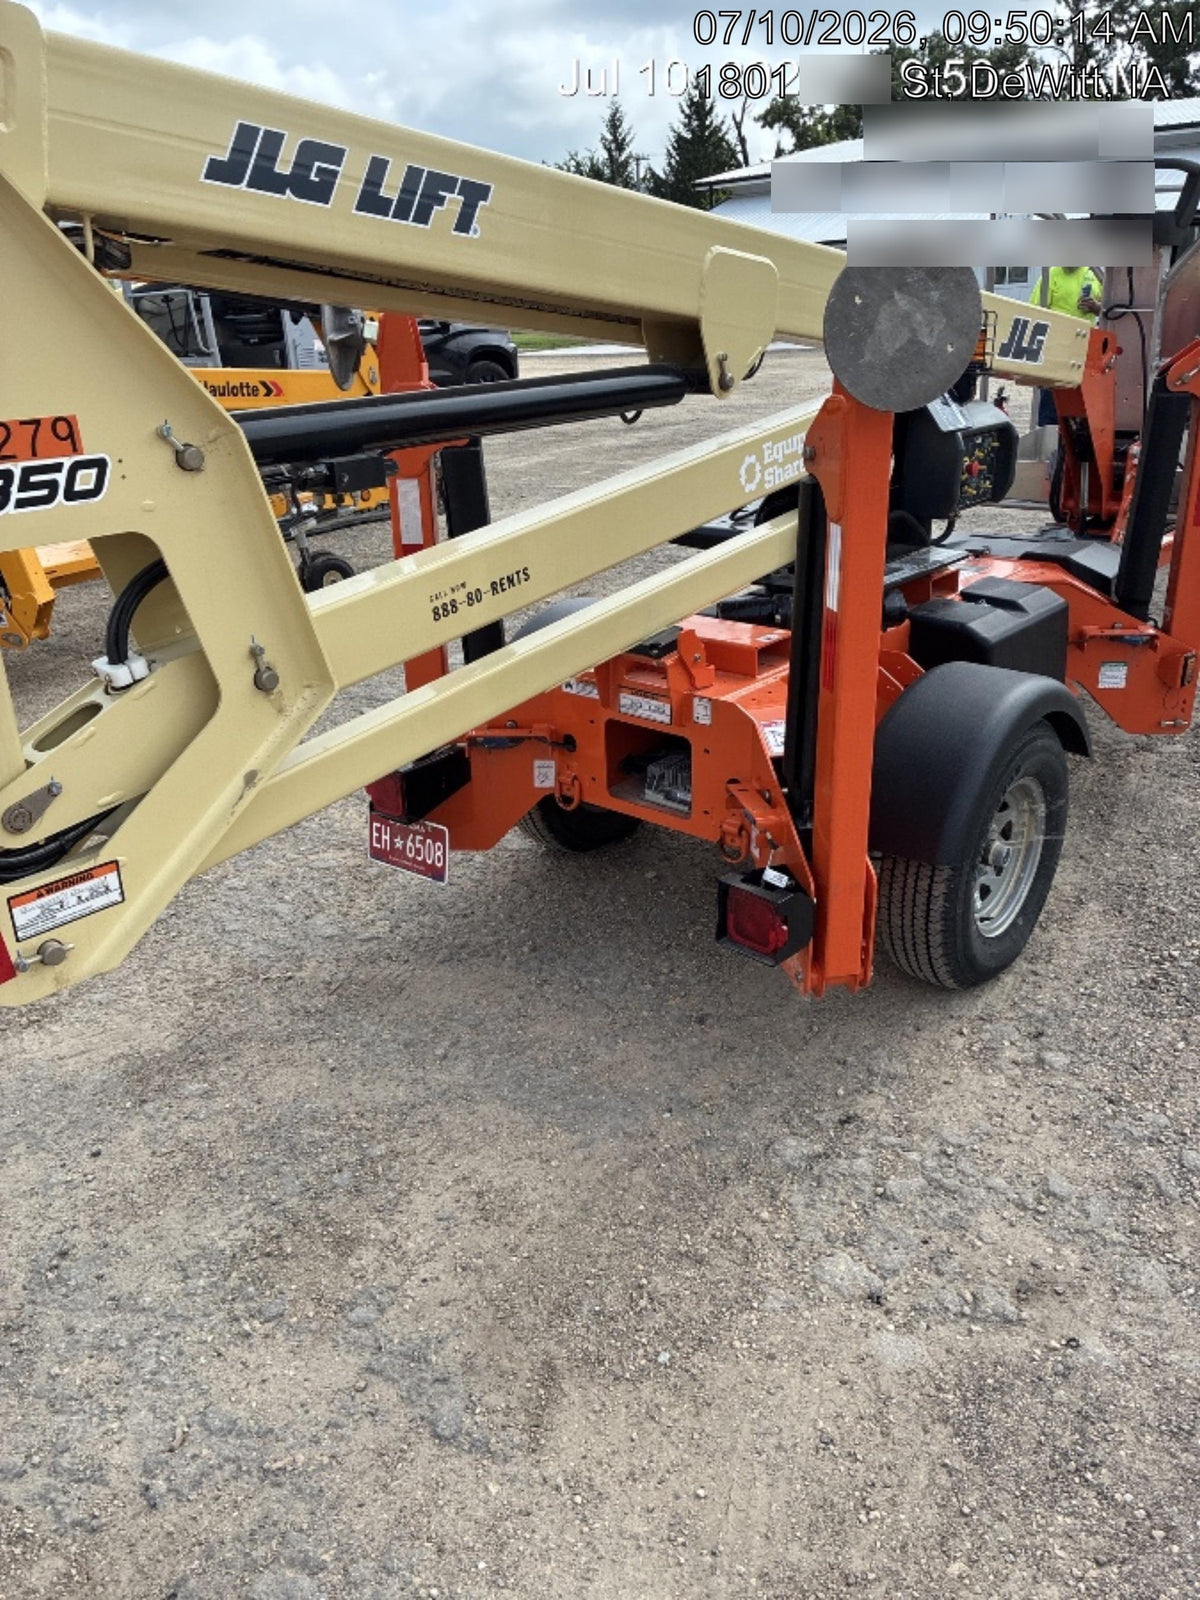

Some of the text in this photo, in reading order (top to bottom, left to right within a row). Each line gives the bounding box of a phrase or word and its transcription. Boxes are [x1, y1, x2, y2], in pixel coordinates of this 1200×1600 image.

[199, 120, 494, 237] JLG LIFT
[995, 315, 1050, 365] JLG
[432, 567, 531, 621] 888-80-RENTS
[372, 822, 391, 852] EH
[406, 833, 444, 869] 6508
[46, 872, 95, 896] WARNING
